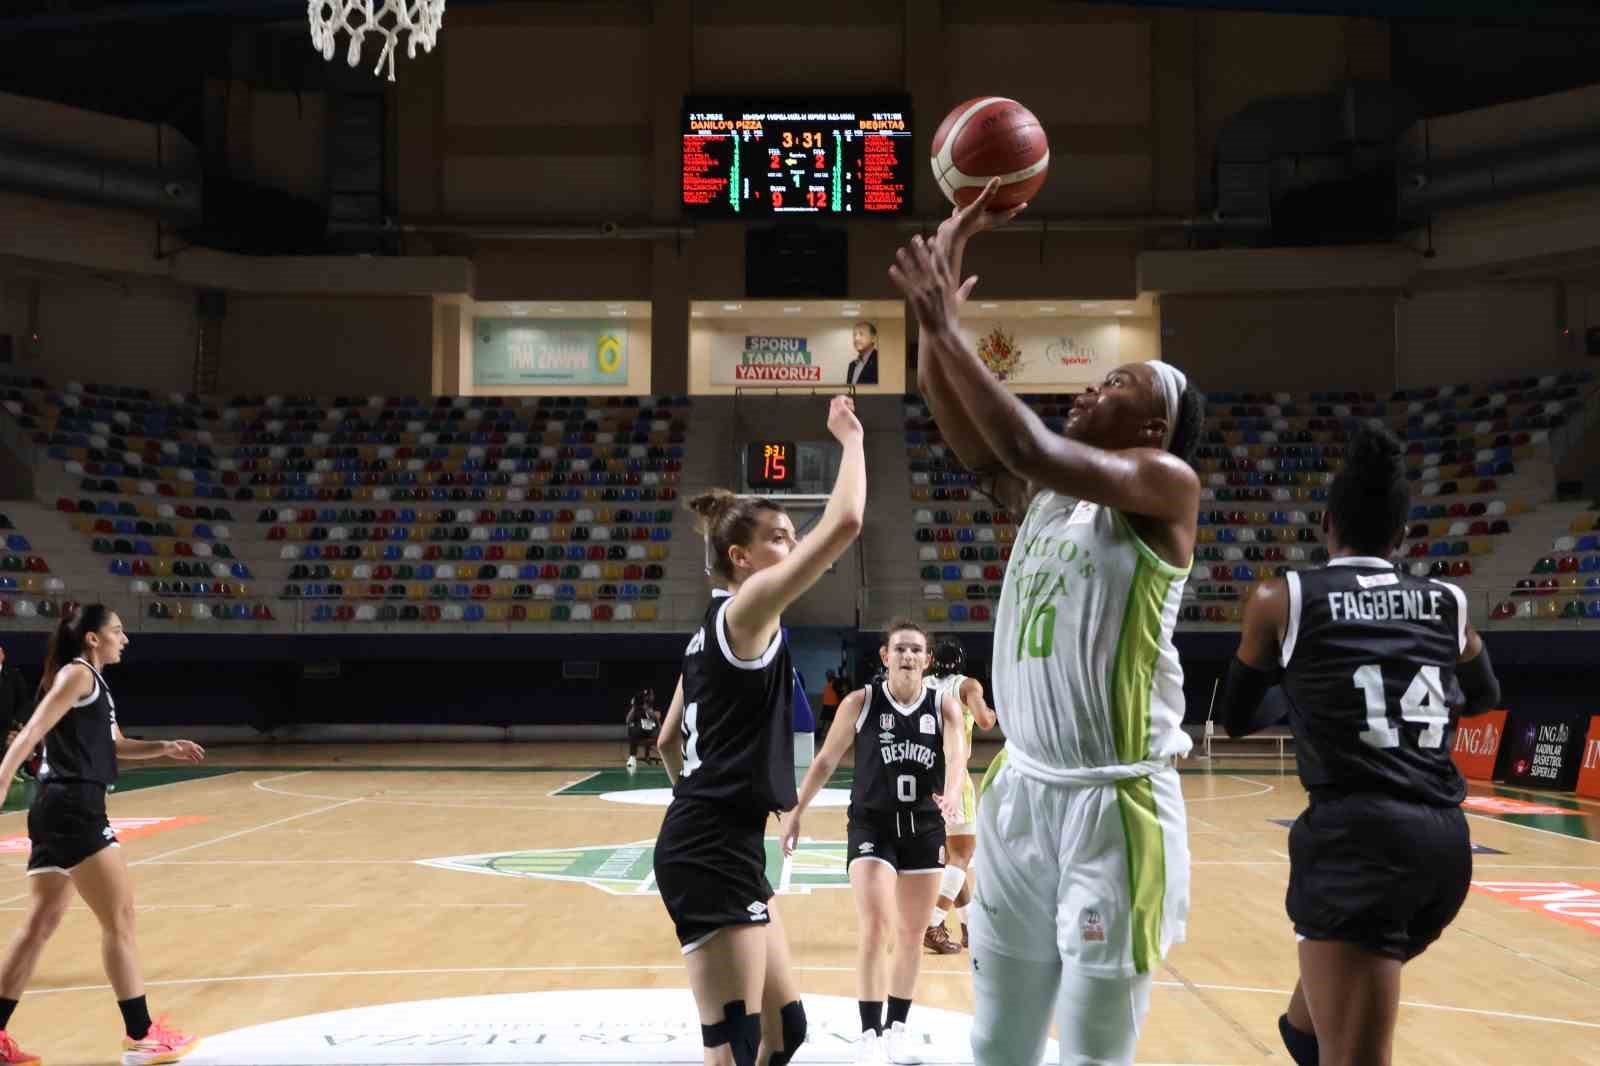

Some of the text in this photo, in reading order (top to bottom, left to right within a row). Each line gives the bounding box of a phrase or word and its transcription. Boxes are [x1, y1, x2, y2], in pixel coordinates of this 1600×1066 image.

[736, 121, 762, 129] PIZZA
[770, 155, 780, 169] 2
[815, 155, 825, 169] 2
[772, 192, 782, 208] 9
[806, 192, 827, 208] 12
[751, 338, 799, 351] SPORU
[747, 353, 806, 365] TABANA
[739, 366, 818, 379] YAYIYORUZ
[764, 456, 785, 479] 15
[1328, 590, 1442, 621] FAGBENLE
[1353, 665, 1450, 748] 14
[1455, 727, 1480, 753] ING
[1538, 725, 1557, 742] ING
[897, 775, 917, 802] 0
